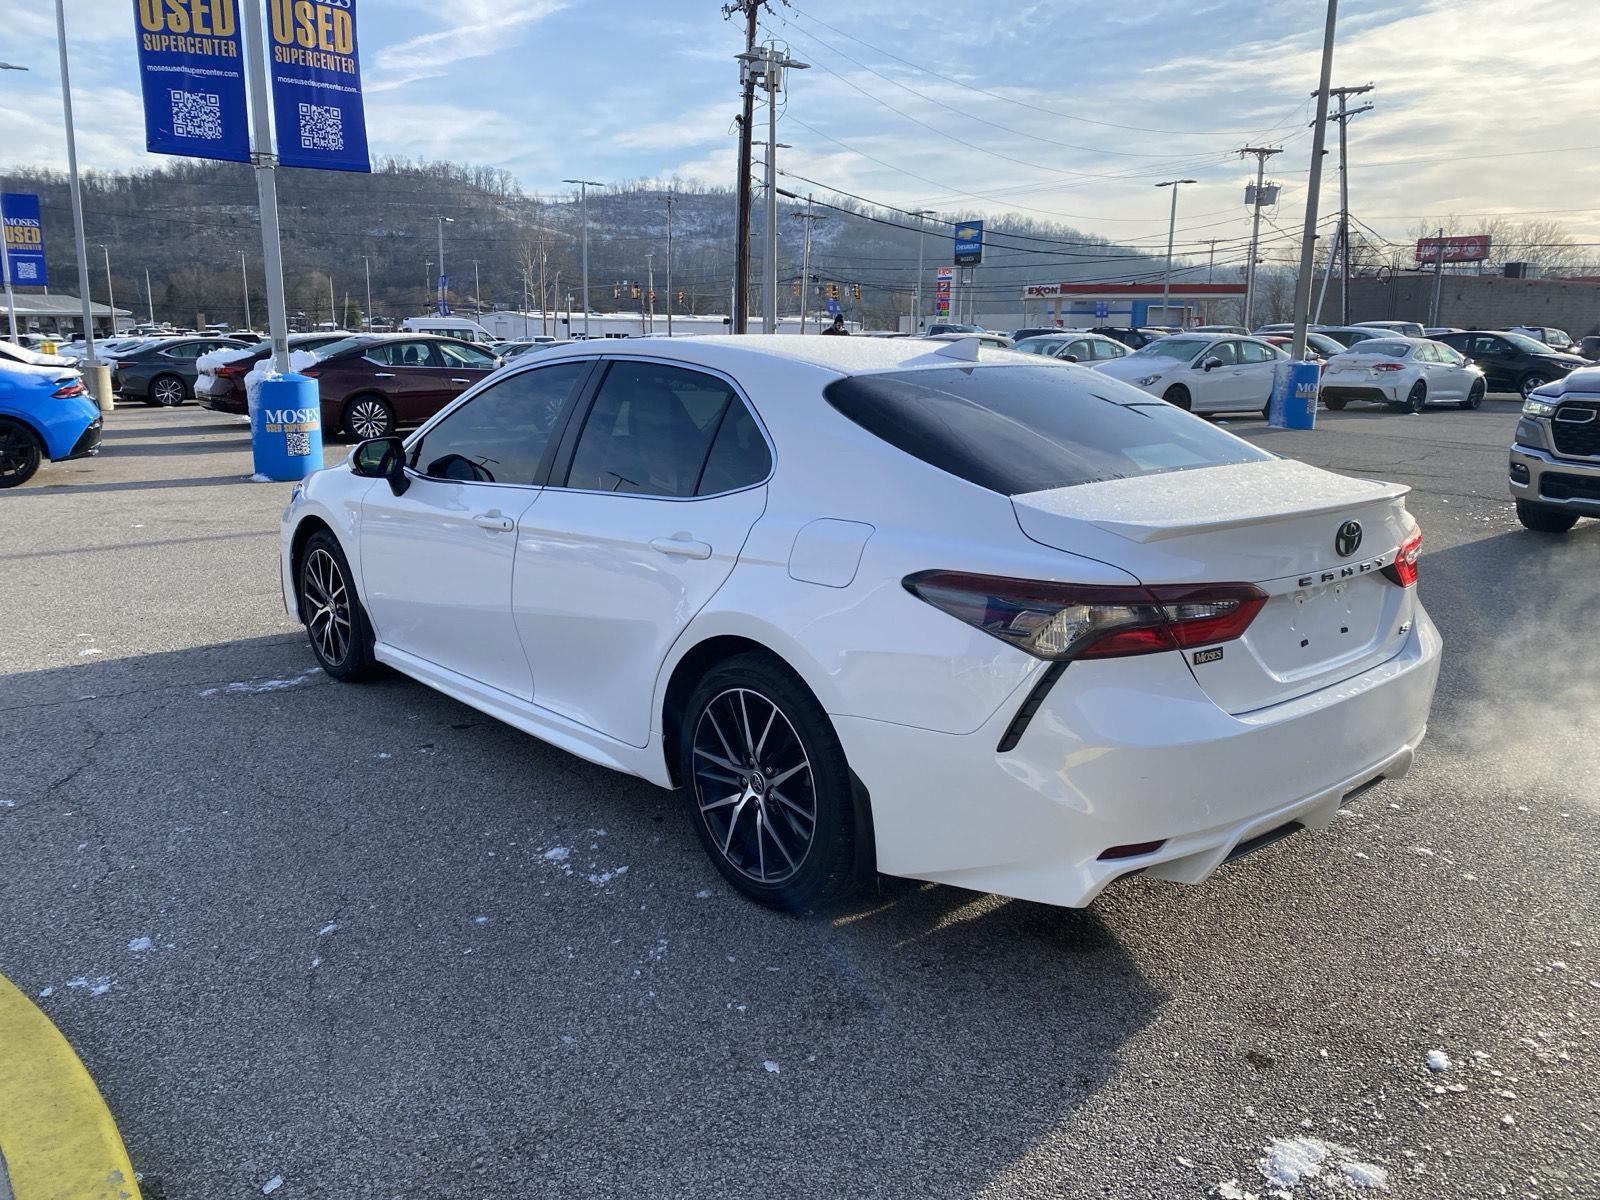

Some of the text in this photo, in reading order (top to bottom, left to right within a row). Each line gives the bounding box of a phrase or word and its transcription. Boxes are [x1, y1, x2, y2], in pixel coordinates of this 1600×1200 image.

[139, 0, 235, 36] USED
[271, 0, 354, 55] USED
[142, 33, 237, 58] SUPERCENTER
[274, 45, 356, 75] SUPERCENTER
[146, 64, 239, 78] mosesusedsupercenter.com
[277, 76, 358, 93] mosesusedsupercenter.com
[4, 217, 40, 226] MOSES
[5, 226, 42, 243] USED
[1028, 286, 1058, 298] EXXON
[1298, 557, 1386, 587] CAMRY
